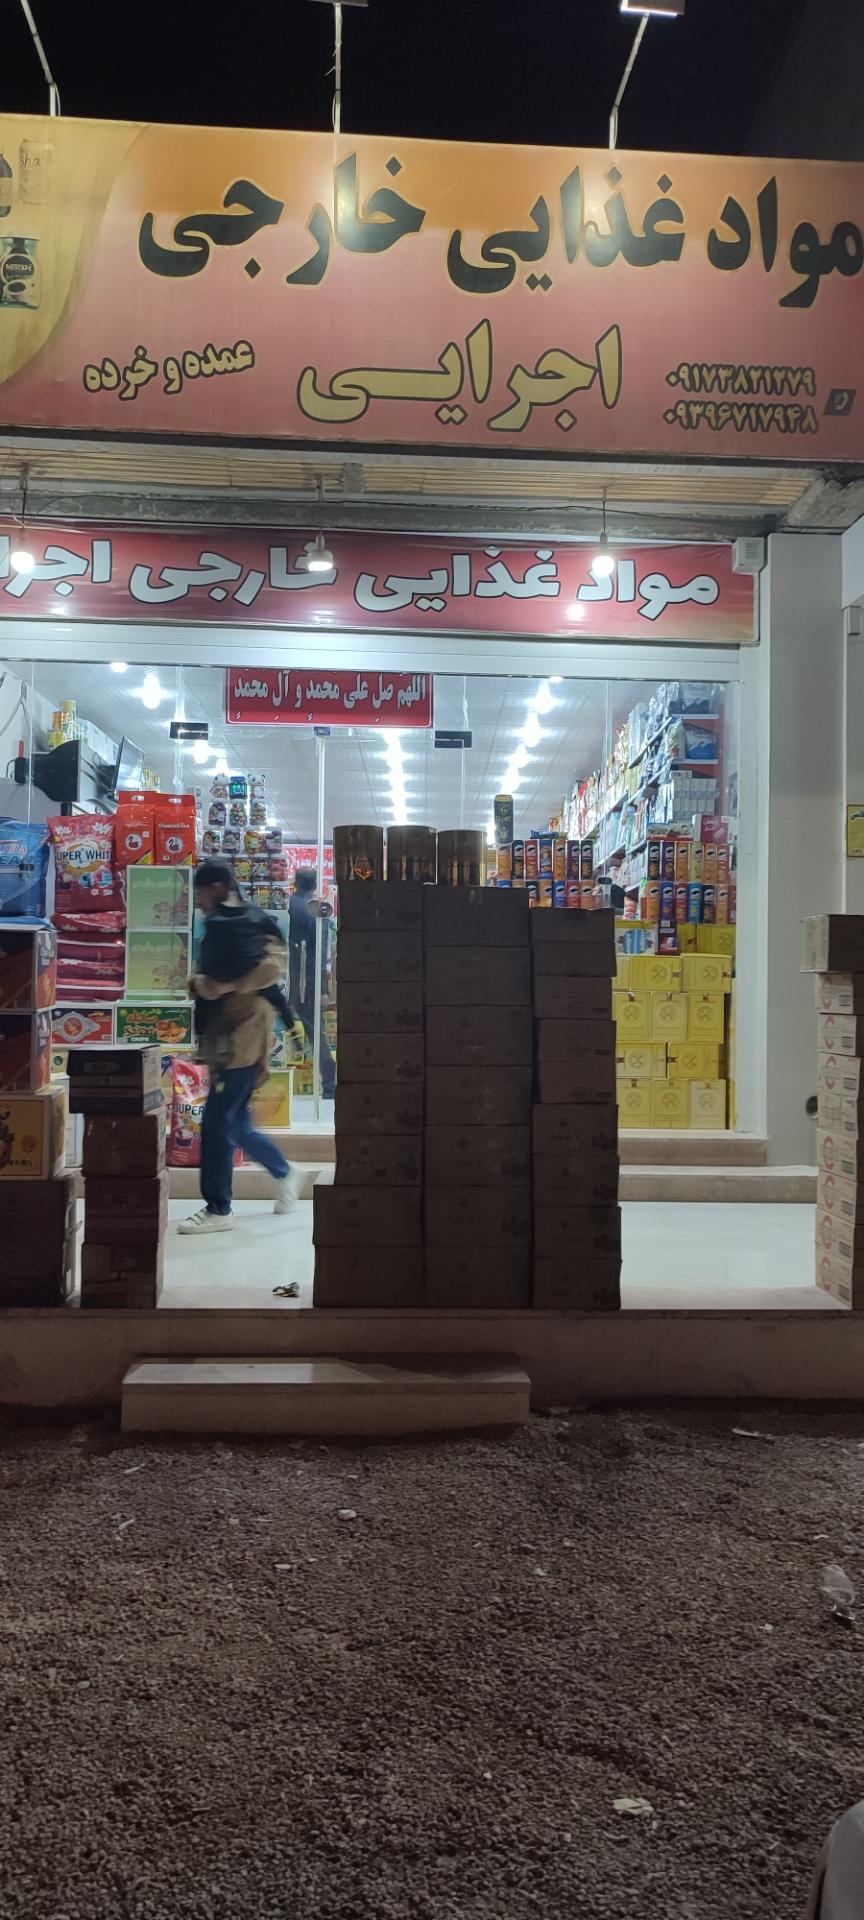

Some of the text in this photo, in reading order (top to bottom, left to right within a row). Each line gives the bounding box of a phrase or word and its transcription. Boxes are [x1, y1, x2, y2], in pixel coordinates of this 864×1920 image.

[138, 151, 864, 309] مواد غذایی خارجی
[83, 340, 255, 401] عمده و خرده
[296, 317, 623, 433] اجرایی
[129, 542, 339, 607] خارجی
[354, 546, 561, 613] غذایی
[576, 556, 720, 621] مواد
